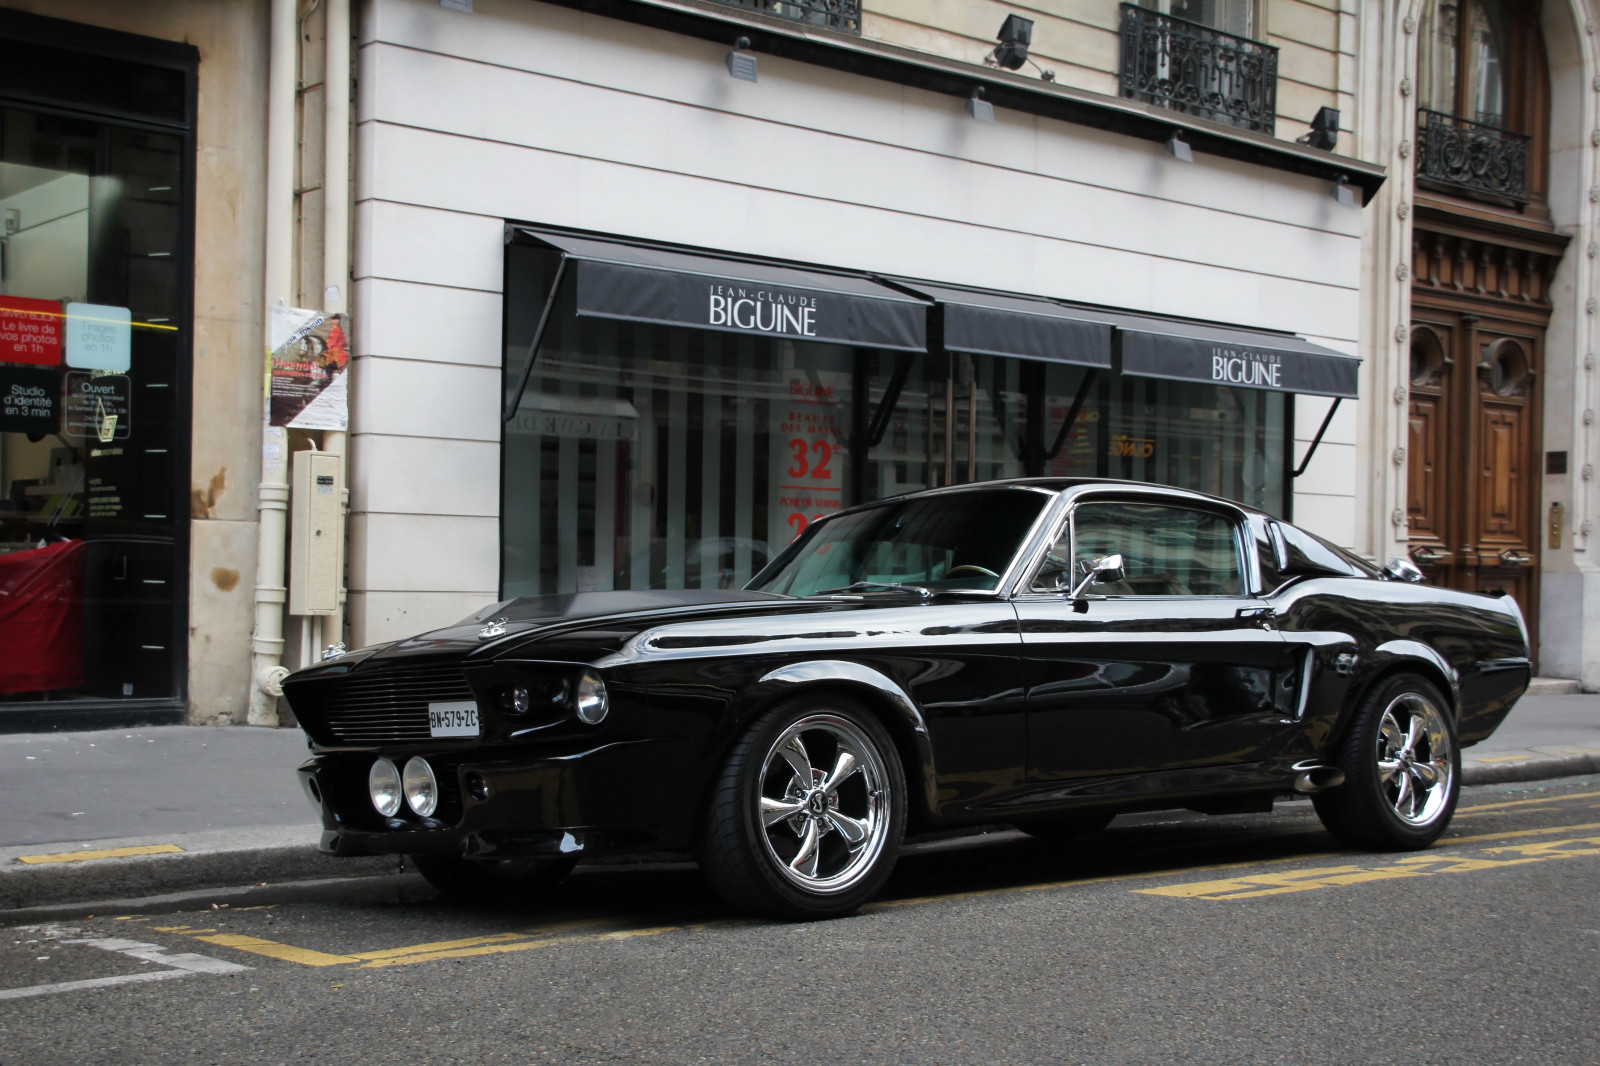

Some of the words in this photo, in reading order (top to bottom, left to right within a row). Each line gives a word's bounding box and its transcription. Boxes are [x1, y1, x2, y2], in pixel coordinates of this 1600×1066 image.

[710, 284, 816, 307] JEAN-CLAUDE
[709, 294, 816, 336] BIGUINE
[2, 321, 16, 331] Le
[18, 322, 39, 333] livre
[41, 325, 55, 335] de
[0, 333, 18, 341] vos
[21, 333, 58, 345] photos
[1212, 347, 1281, 363] JEAN-CLAUDE
[1212, 356, 1281, 387] BIGUINE
[11, 384, 46, 397] Studio
[81, 382, 116, 394] Ouvert
[3, 395, 52, 407] d'identité
[5, 407, 19, 415] en
[21, 407, 29, 416] 3
[31, 407, 51, 417] min
[430, 709, 477, 729] BN-579-ZC
